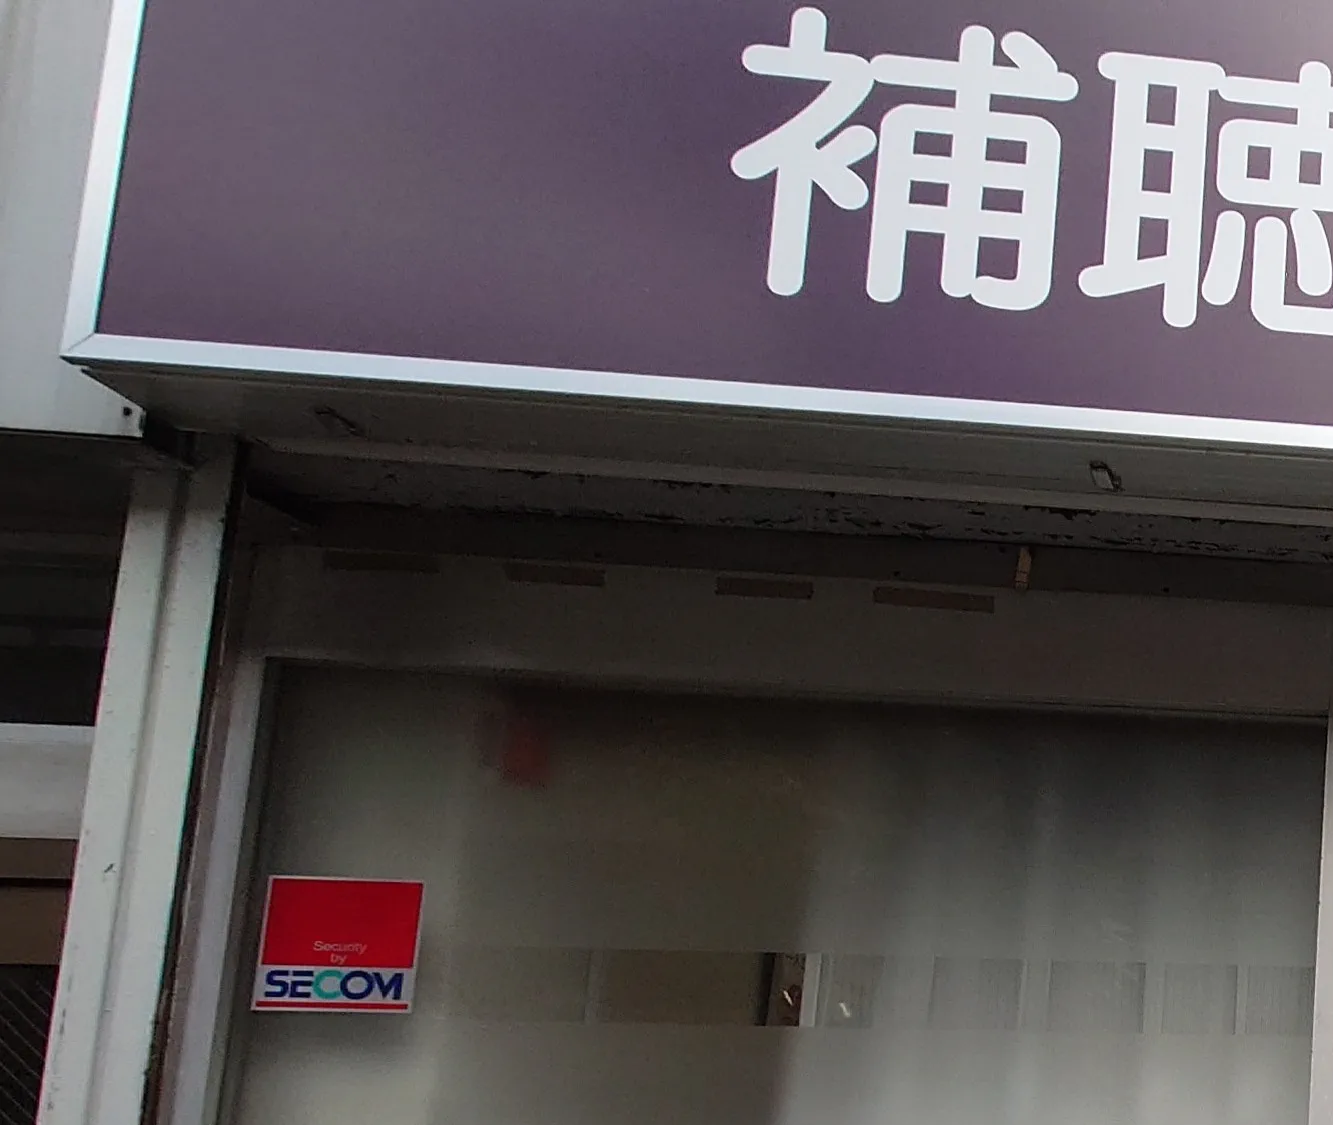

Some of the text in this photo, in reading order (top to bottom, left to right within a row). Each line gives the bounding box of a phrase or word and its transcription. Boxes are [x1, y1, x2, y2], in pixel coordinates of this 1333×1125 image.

[313, 941, 367, 954] Security
[330, 953, 347, 965] by
[264, 970, 404, 1000] SECOM
